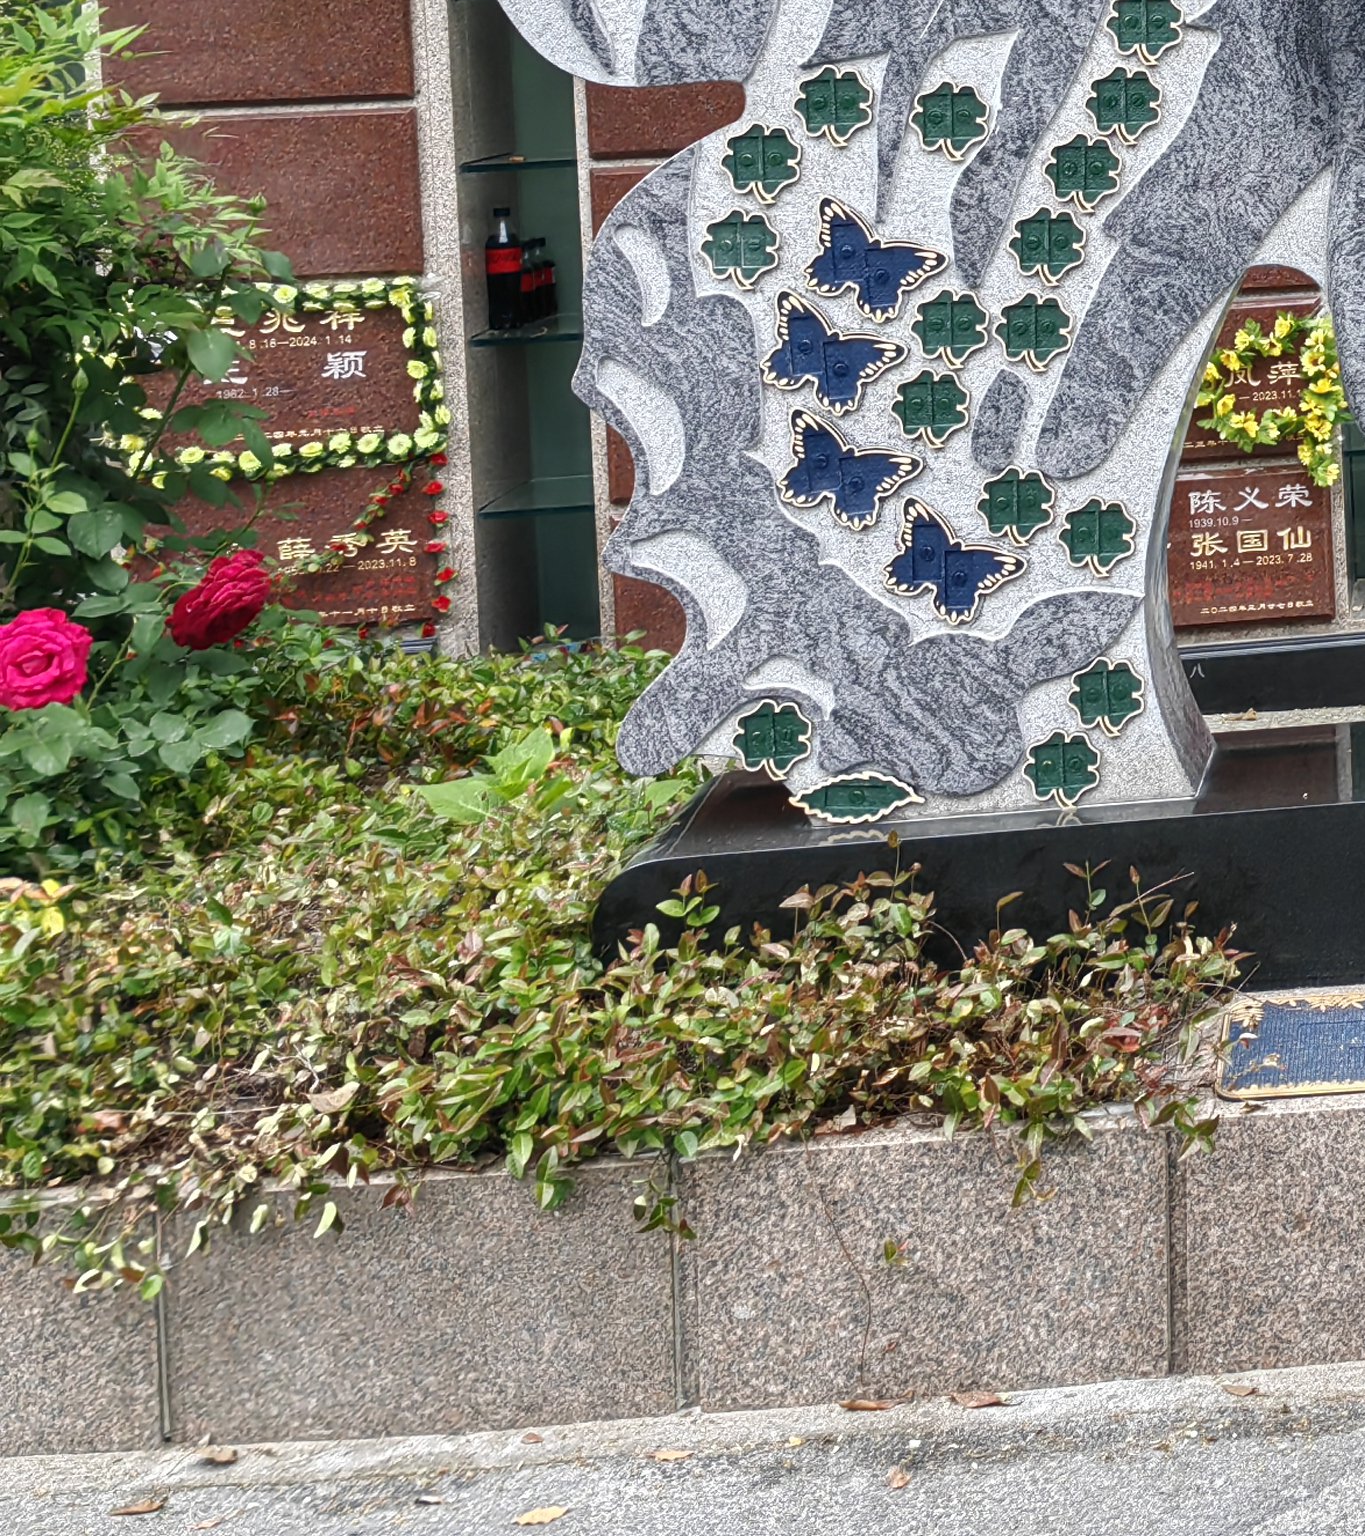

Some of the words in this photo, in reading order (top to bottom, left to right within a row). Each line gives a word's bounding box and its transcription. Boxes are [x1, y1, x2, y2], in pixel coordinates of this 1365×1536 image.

[1188, 483, 1313, 515] 陈义荣
[277, 528, 418, 561] 薛秀英
[1190, 526, 1313, 557] 张国仙
